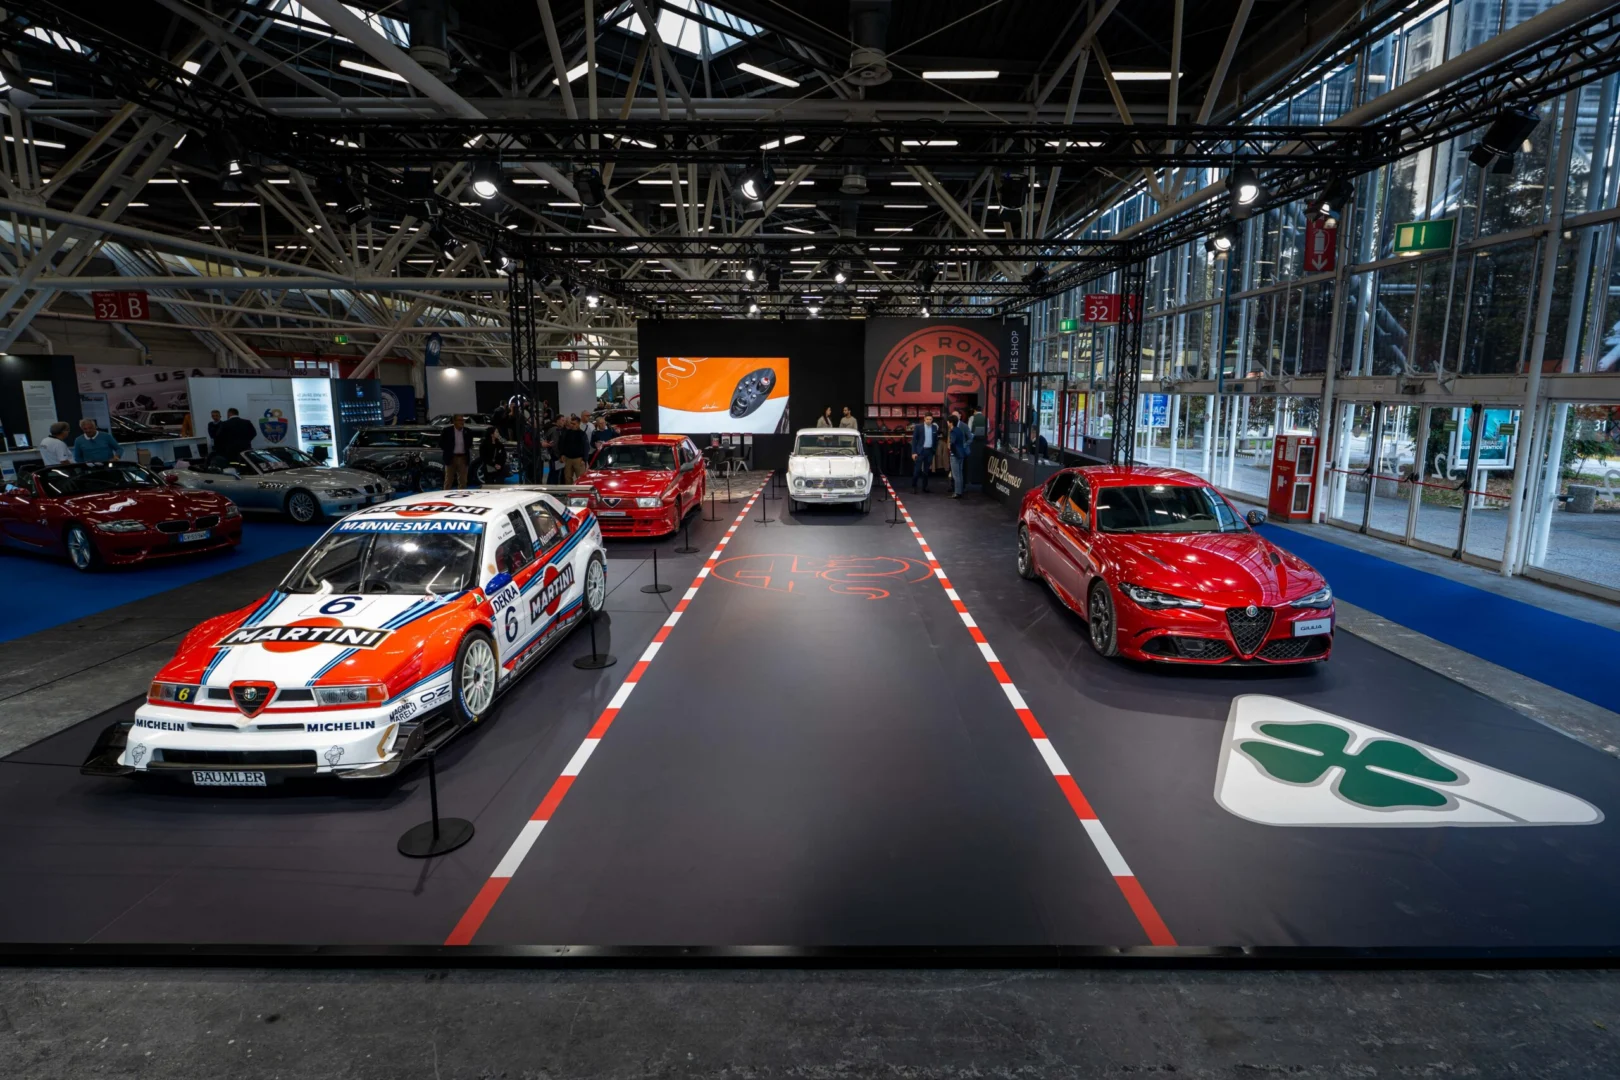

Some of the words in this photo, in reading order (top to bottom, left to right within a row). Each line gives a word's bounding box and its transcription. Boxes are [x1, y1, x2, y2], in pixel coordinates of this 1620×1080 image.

[98, 303, 118, 319] 32
[128, 297, 142, 319] B
[1088, 305, 1108, 321] 32
[1010, 330, 1019, 356] SHOP
[885, 344, 926, 397] ALFA
[1010, 358, 1018, 374] THE
[1594, 420, 1607, 432] 31
[987, 455, 1000, 484] Alfa
[1000, 458, 1023, 489] Romeo
[365, 504, 486, 514] MARTINI
[339, 521, 472, 532] MANNESMANN
[493, 584, 518, 614] DEKRA
[532, 566, 574, 619] MARTINI
[319, 596, 363, 614] 6
[505, 606, 518, 642] 6
[225, 628, 381, 645] MARTINI
[178, 688, 190, 700] 6
[136, 718, 184, 732] MICHELIN
[307, 720, 376, 732] MICHELIN
